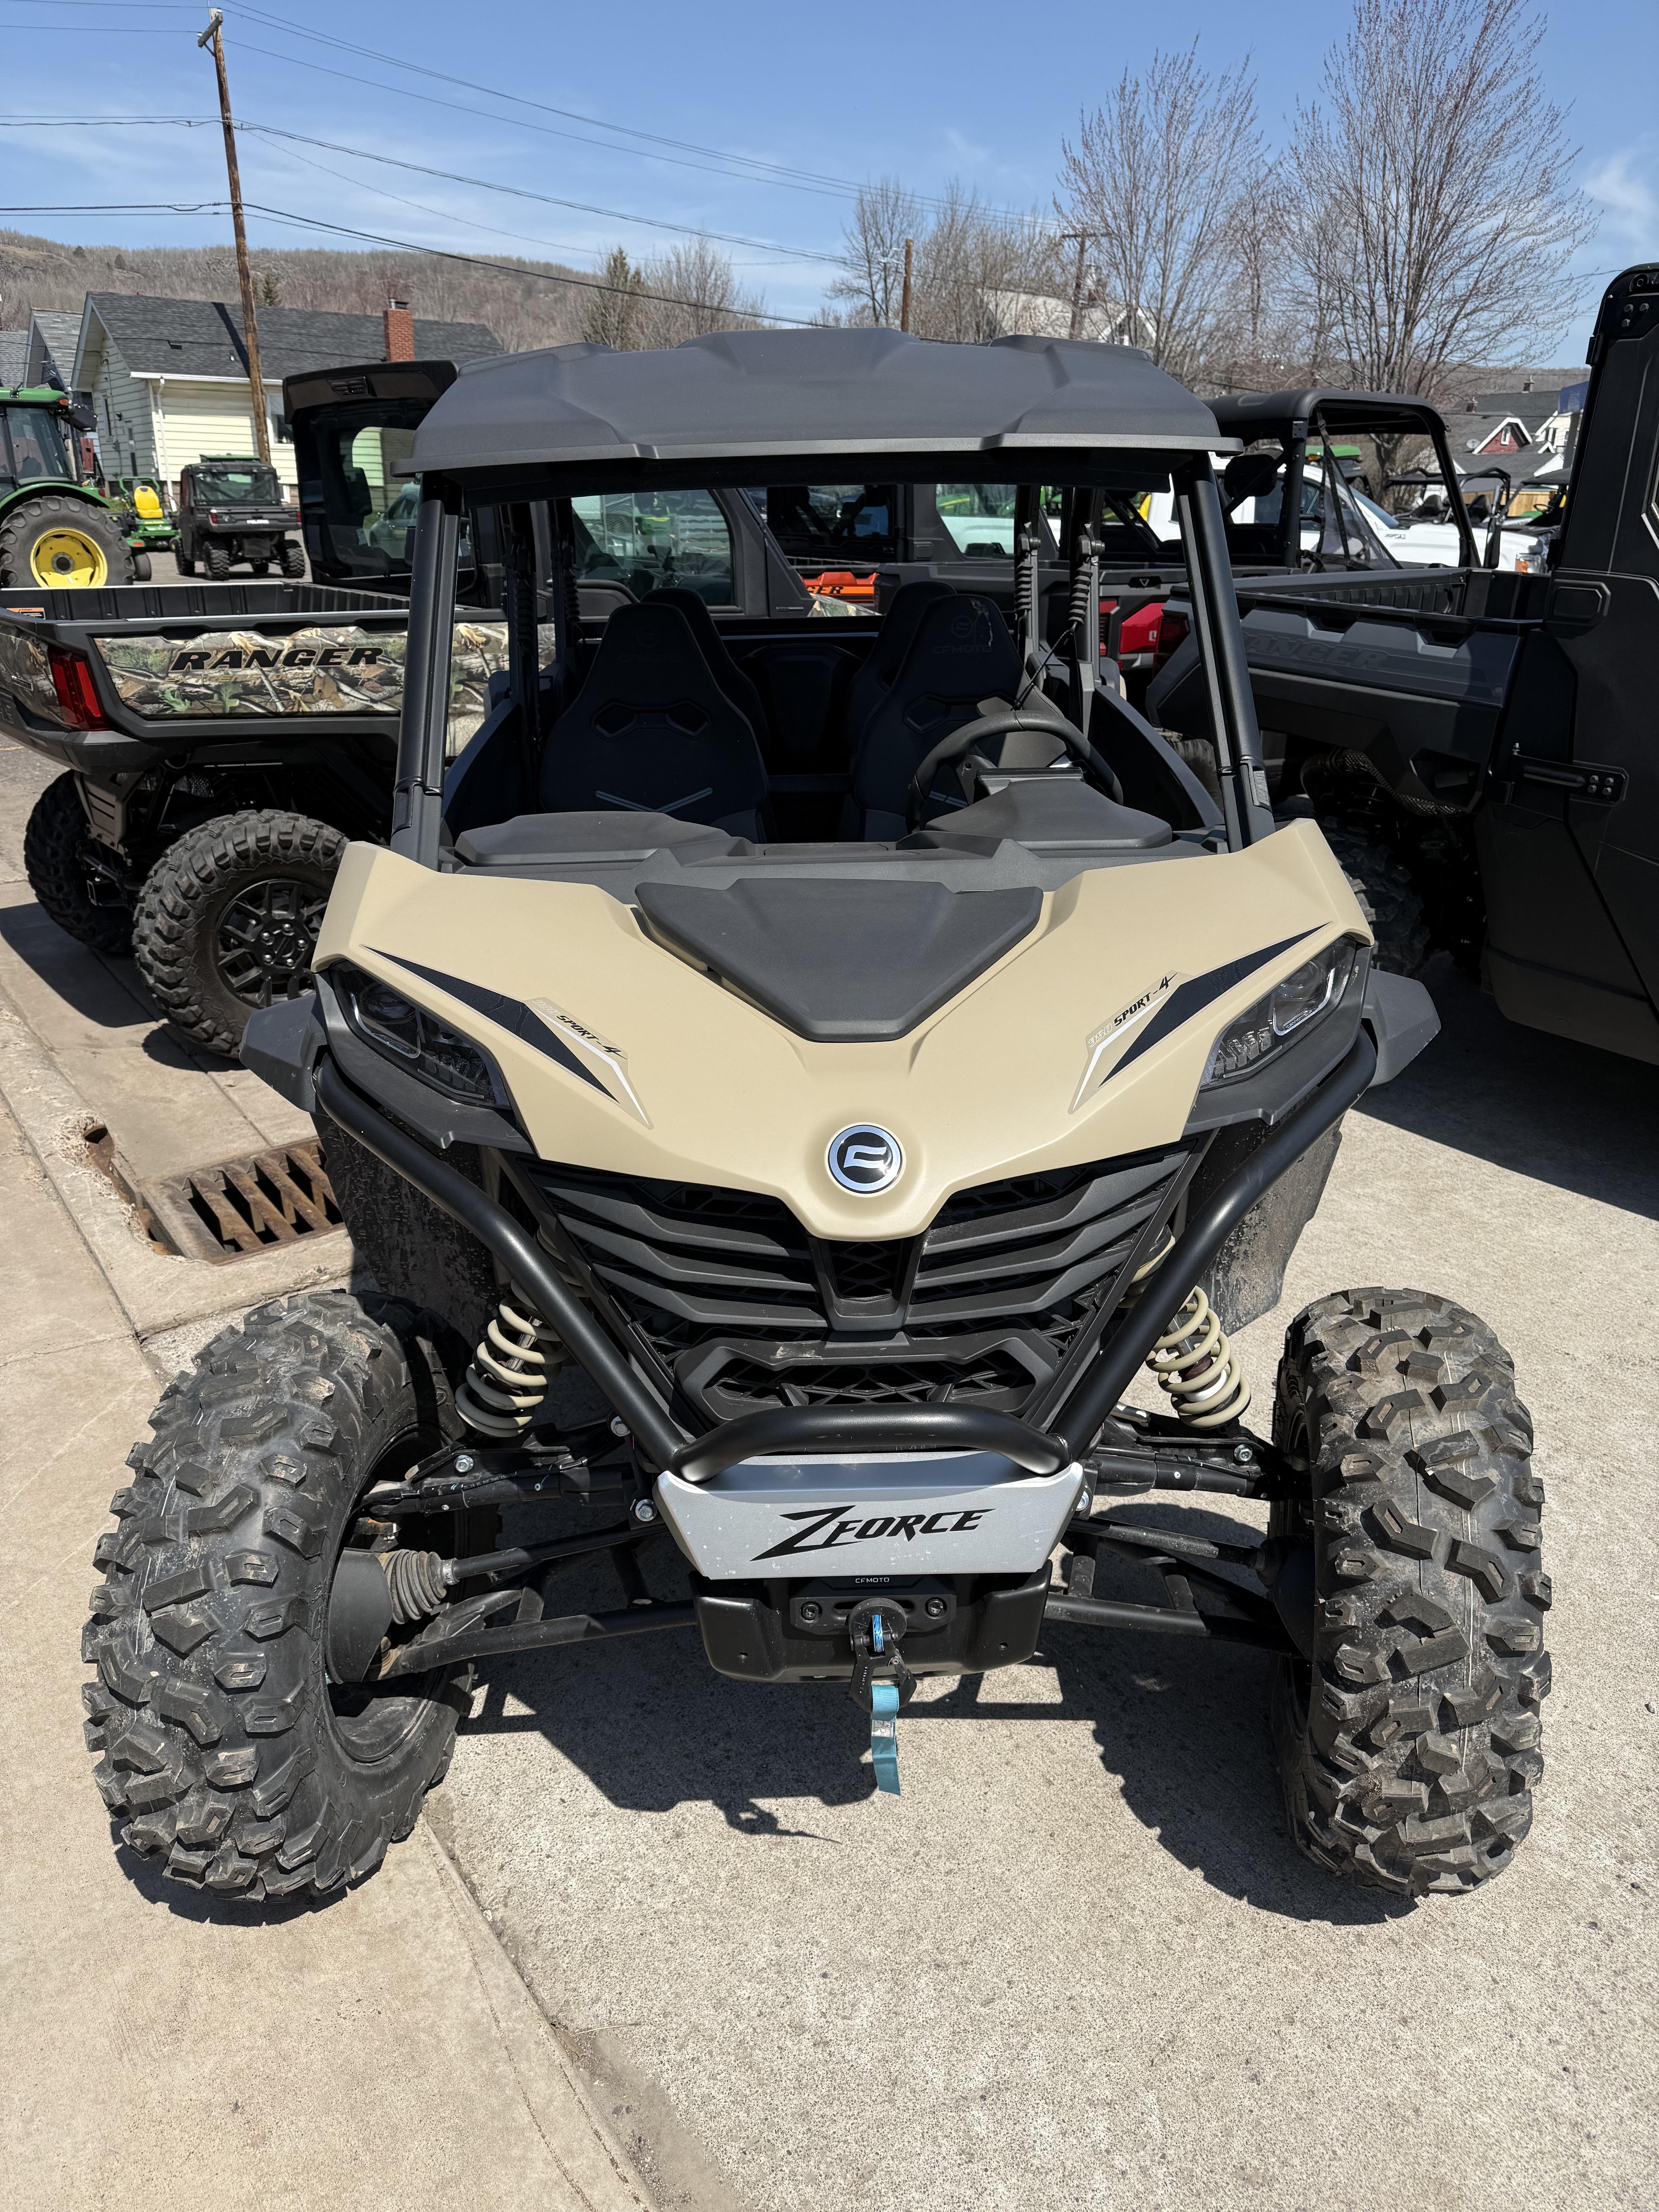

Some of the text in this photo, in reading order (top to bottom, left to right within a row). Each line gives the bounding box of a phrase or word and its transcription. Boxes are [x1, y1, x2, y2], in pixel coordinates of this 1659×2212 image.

[168, 647, 384, 672] RANGER
[933, 644, 991, 654] CFMOTO
[1242, 632, 1388, 671] ANGER
[161, 673, 262, 684] EXTREME
[1088, 1023, 1112, 1048] 950
